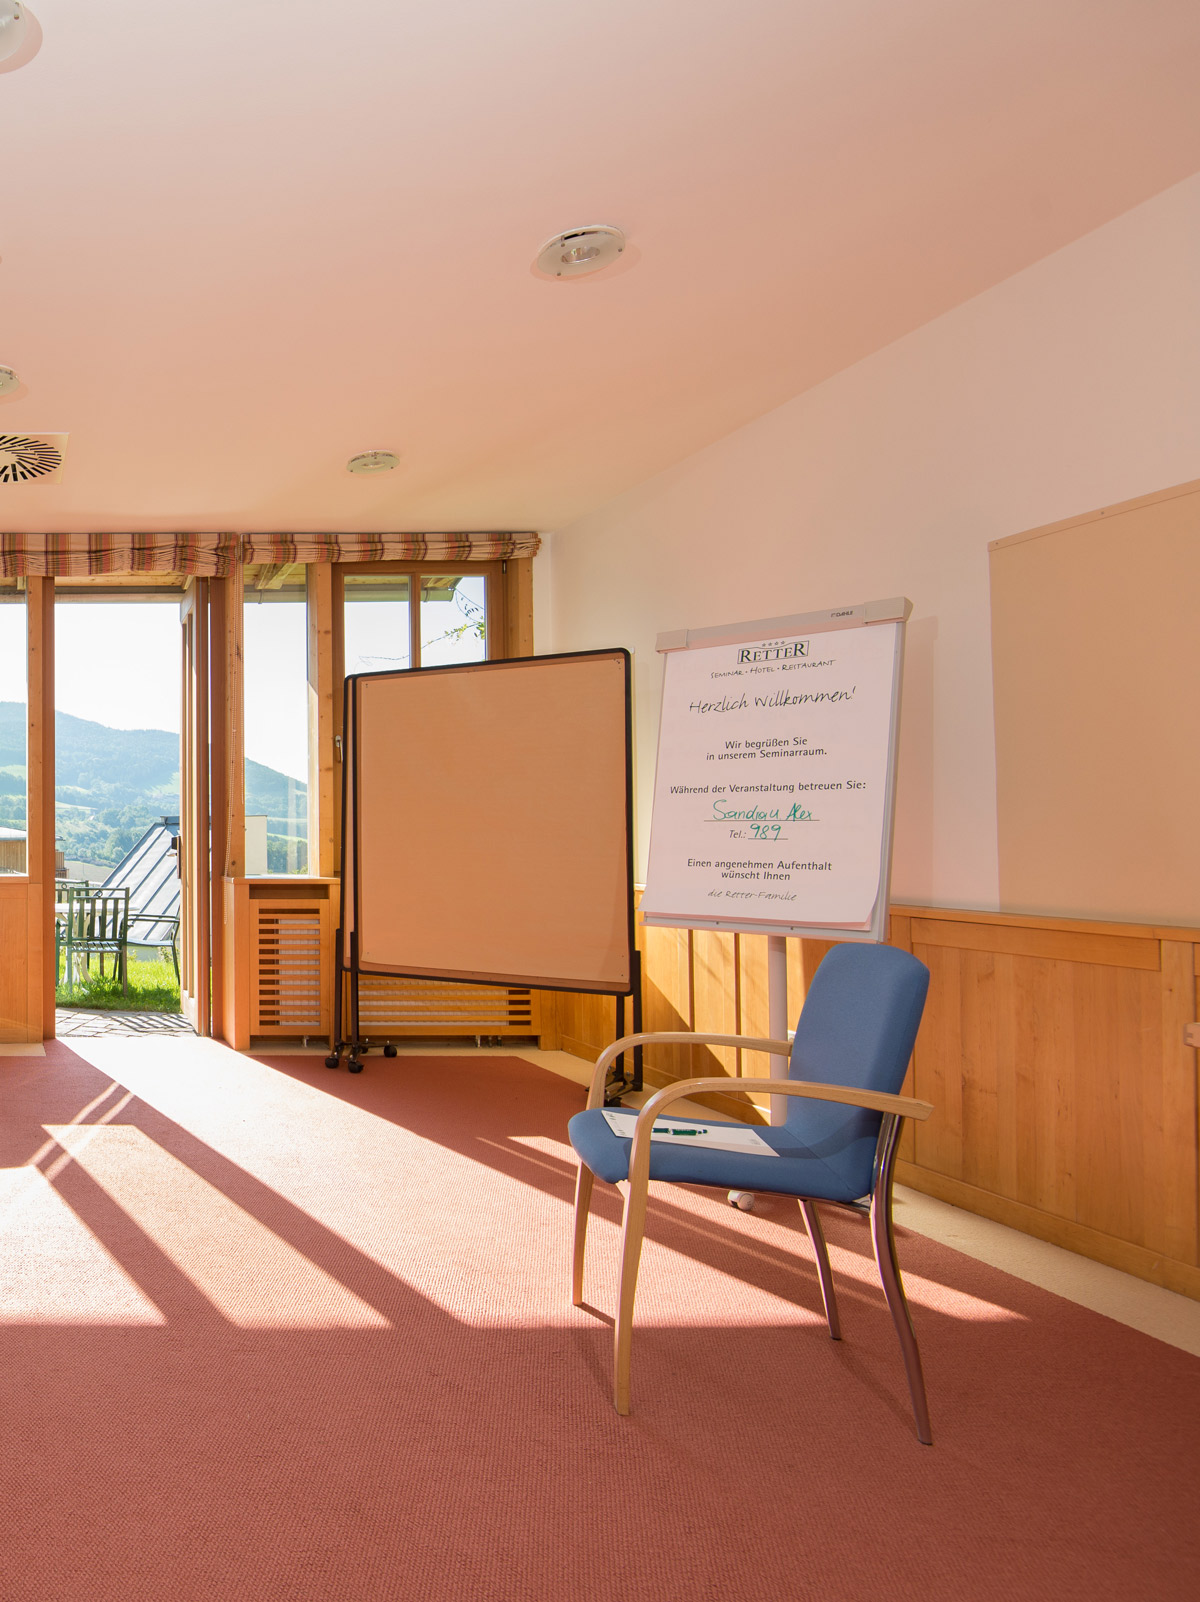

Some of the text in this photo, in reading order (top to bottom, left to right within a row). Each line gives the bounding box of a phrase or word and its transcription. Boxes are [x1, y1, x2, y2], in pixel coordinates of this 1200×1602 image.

[739, 643, 806, 662] RETTER
[710, 660, 836, 679] SEMINAR HOTEL RESTAURANT
[689, 686, 857, 714] Herzlich Willkommen!
[725, 737, 808, 750] Wir begrüßen Sie
[706, 748, 827, 760] in unserem Seminarraum.
[670, 780, 866, 794] Während der Veranstaltung betreuen Sie:
[729, 823, 782, 842] Tel.: 989
[687, 858, 832, 871] Einen angenehmen Aufenthalt
[721, 870, 791, 881] wünscht Ihnen
[707, 888, 798, 902] die Retter-Familie
